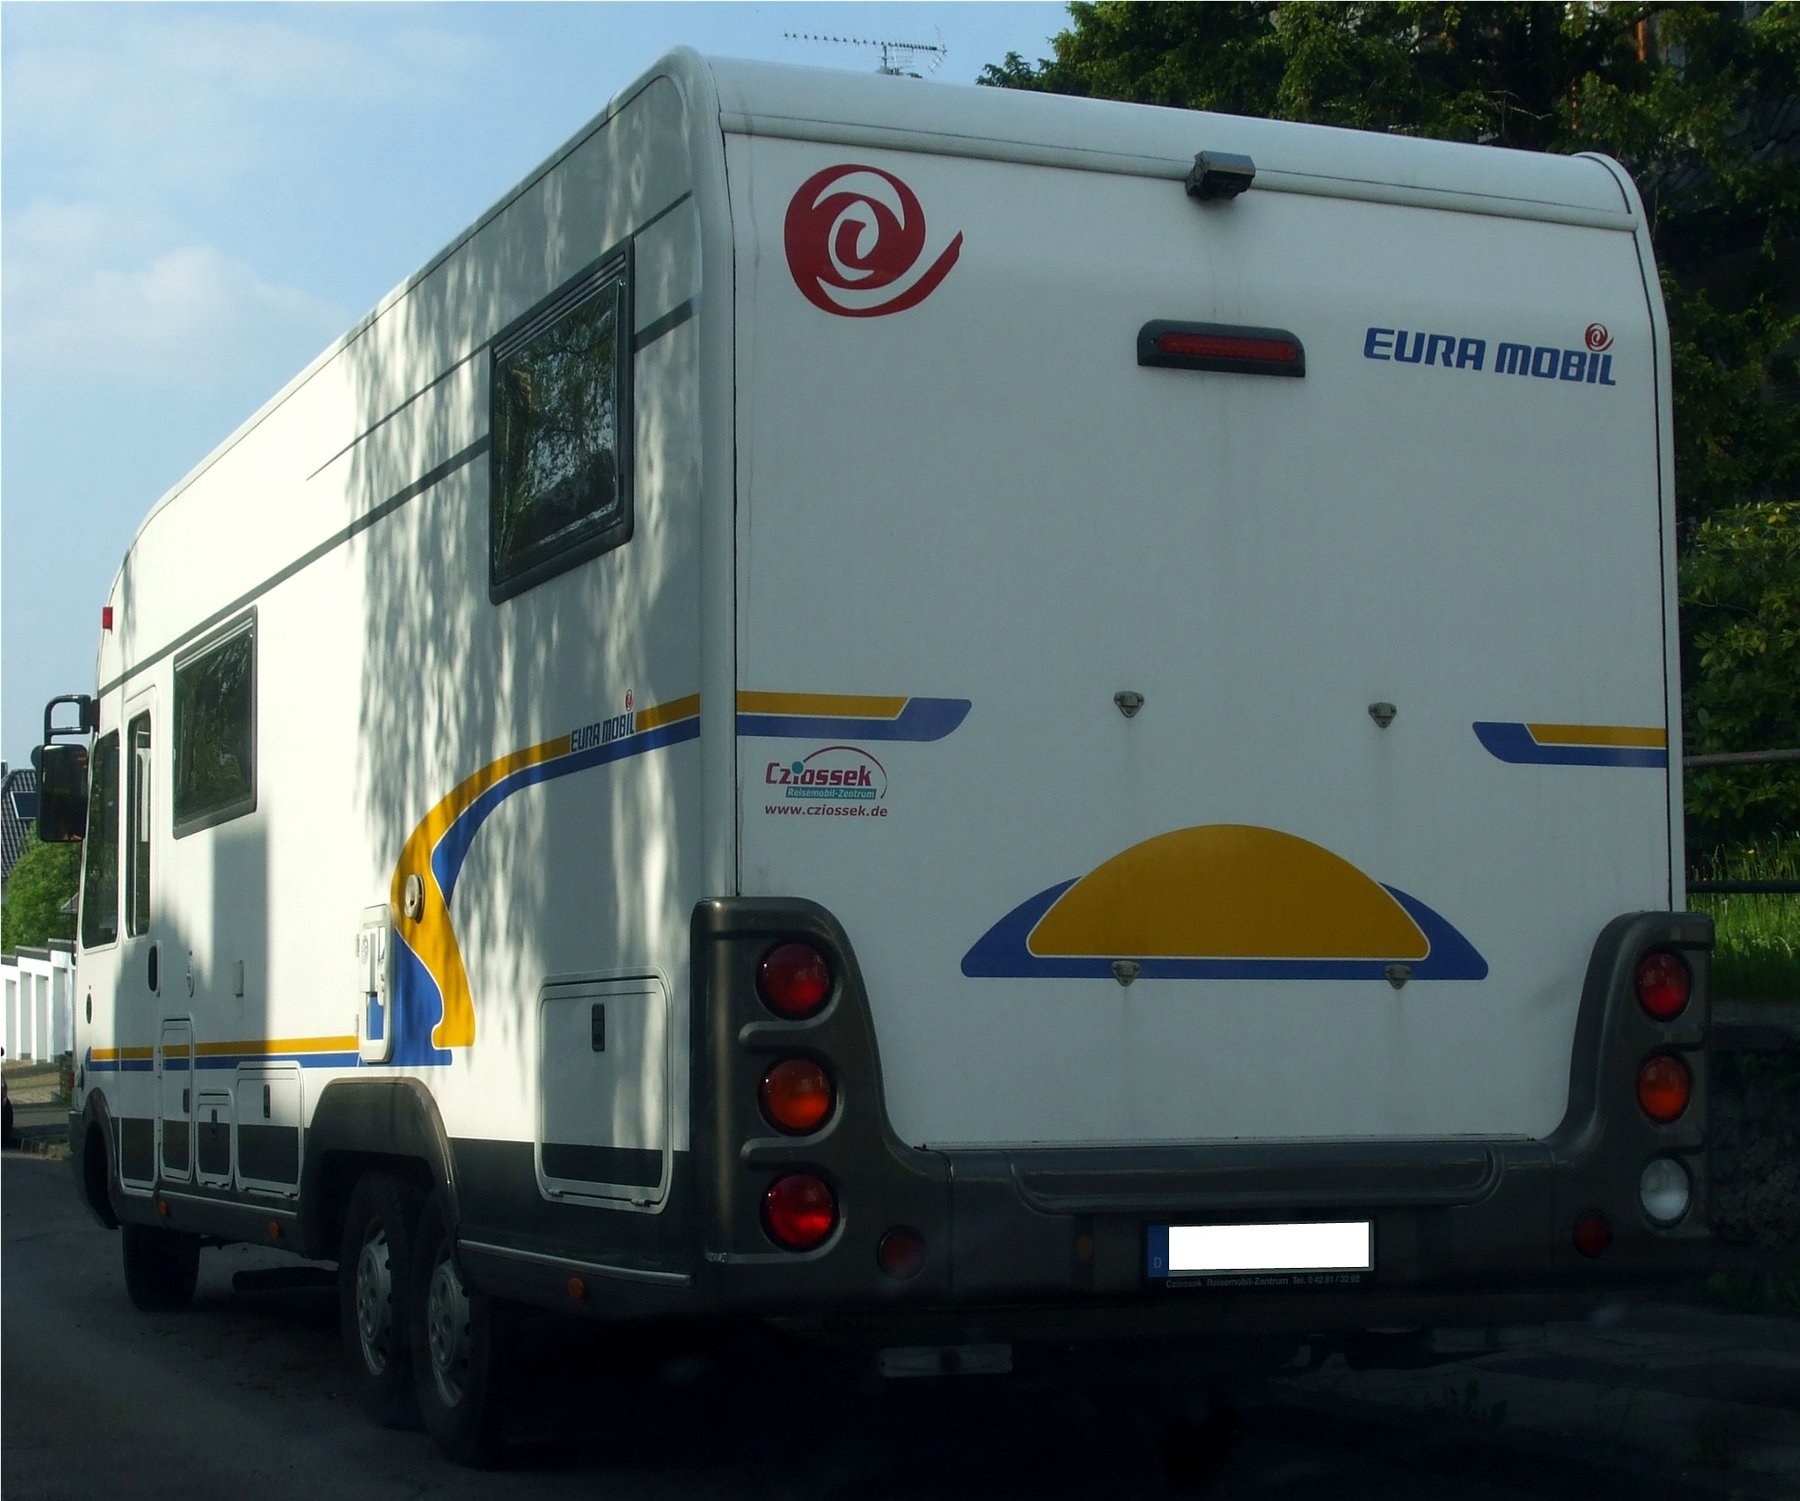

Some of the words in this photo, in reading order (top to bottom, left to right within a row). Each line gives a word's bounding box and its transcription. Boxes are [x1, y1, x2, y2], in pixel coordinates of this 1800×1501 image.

[1363, 327, 1486, 371] EURA
[1494, 342, 1616, 386] MOBIL
[571, 723, 600, 752] EURA
[602, 711, 634, 743] MOBIL
[765, 762, 872, 786] Cziossek
[787, 787, 875, 799] Reisemobil-Zentrum
[765, 804, 888, 817] www.cziossek.de
[1153, 1257, 1162, 1268] D
